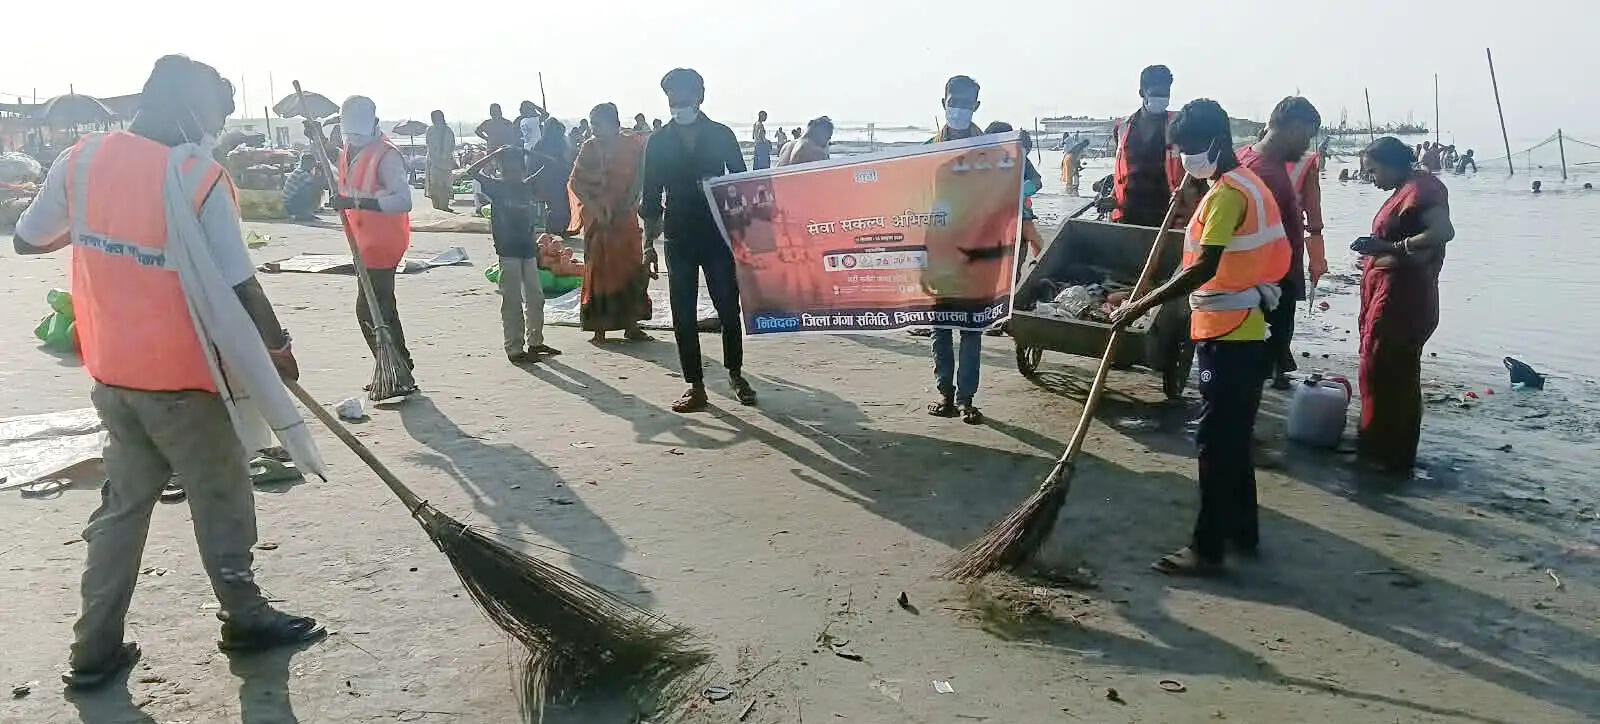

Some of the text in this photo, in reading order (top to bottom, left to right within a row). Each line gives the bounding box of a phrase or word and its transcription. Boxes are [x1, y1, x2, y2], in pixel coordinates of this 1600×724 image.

[807, 220, 835, 235] सेवा
[802, 313, 830, 327] जिला
[832, 312, 854, 326] गंगा
[894, 311, 925, 325] जिला
[973, 303, 1004, 322] कटिहार
